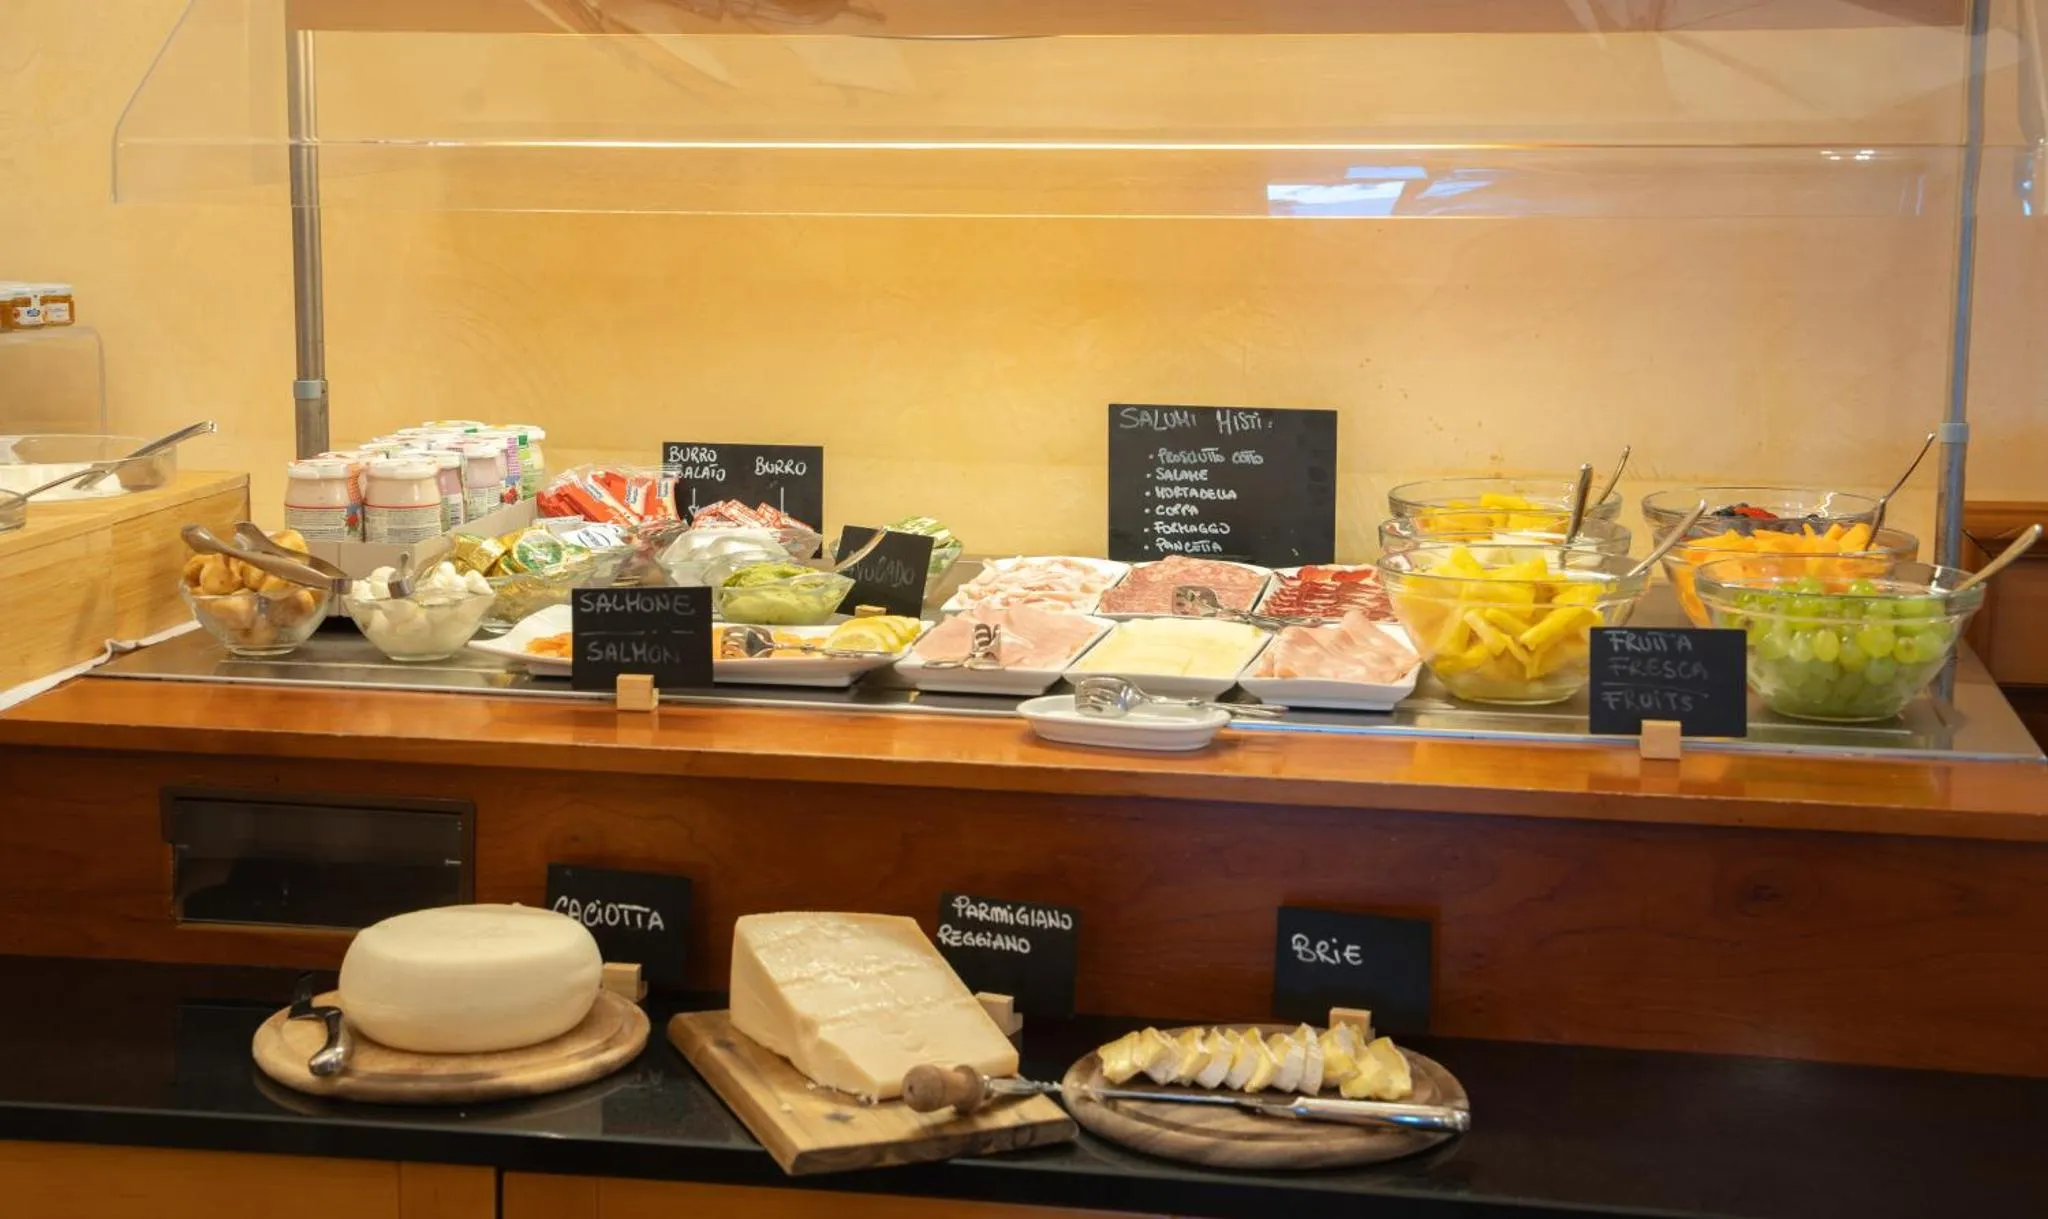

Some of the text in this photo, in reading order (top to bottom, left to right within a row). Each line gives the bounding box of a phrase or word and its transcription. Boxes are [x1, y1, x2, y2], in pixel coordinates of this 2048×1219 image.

[668, 445, 718, 464] BURRO
[754, 456, 807, 476] BURRO
[1155, 466, 1209, 481] SALAME
[1155, 503, 1199, 516] COPPA
[1155, 537, 1222, 553] PANCETTA
[579, 591, 695, 616] SALMONE
[1607, 656, 1709, 681] FRESCA
